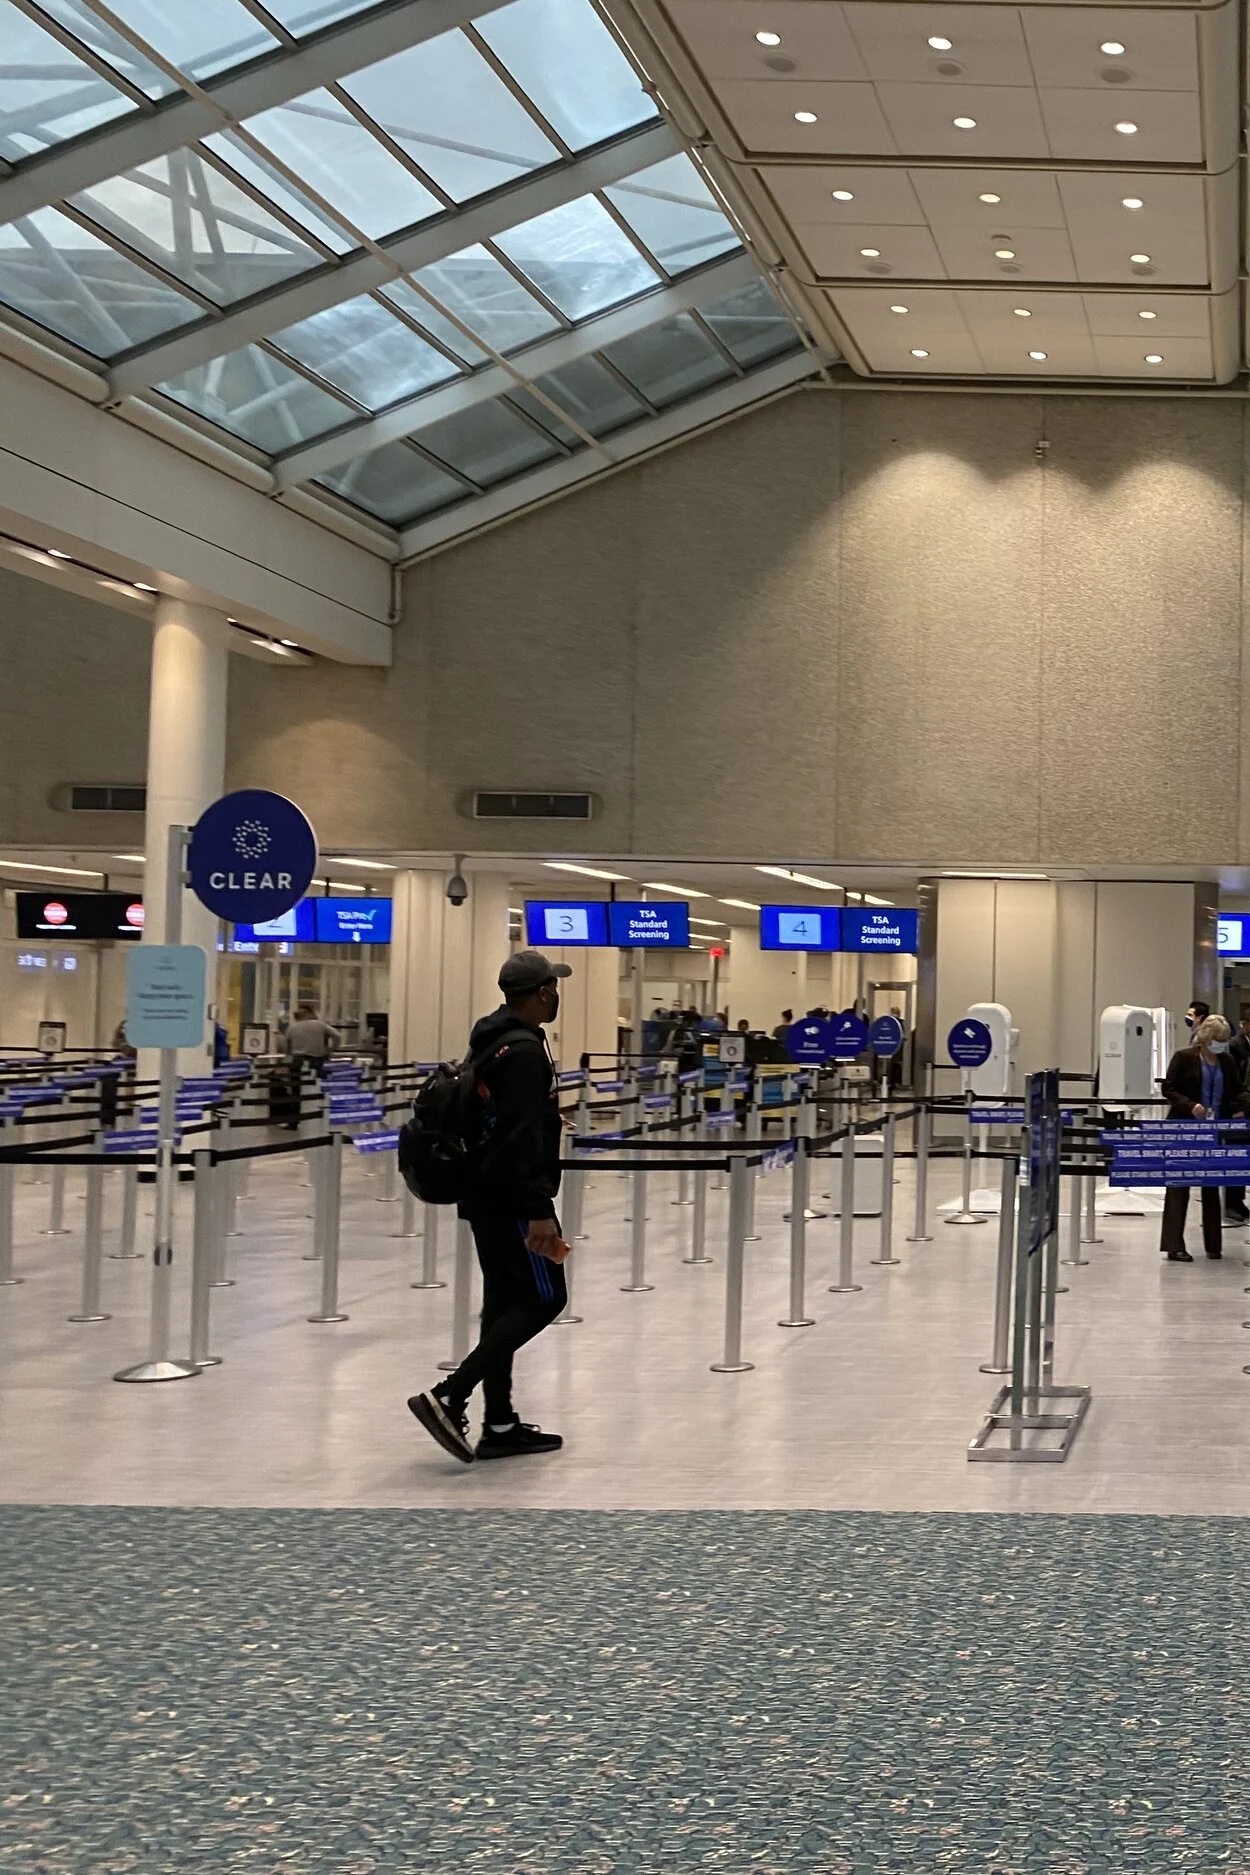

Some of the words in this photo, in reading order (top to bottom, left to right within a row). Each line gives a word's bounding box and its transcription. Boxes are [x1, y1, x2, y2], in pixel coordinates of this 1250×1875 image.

[209, 872, 291, 889] CLEAR
[639, 910, 657, 918] TSA
[559, 915, 574, 932] 3
[629, 920, 667, 929] Standard
[872, 916, 889, 924] TSA
[792, 920, 808, 937] 4
[862, 926, 899, 934] Standard
[629, 930, 669, 940] Screening
[1218, 927, 1229, 943] 5
[861, 936, 901, 946] Screening
